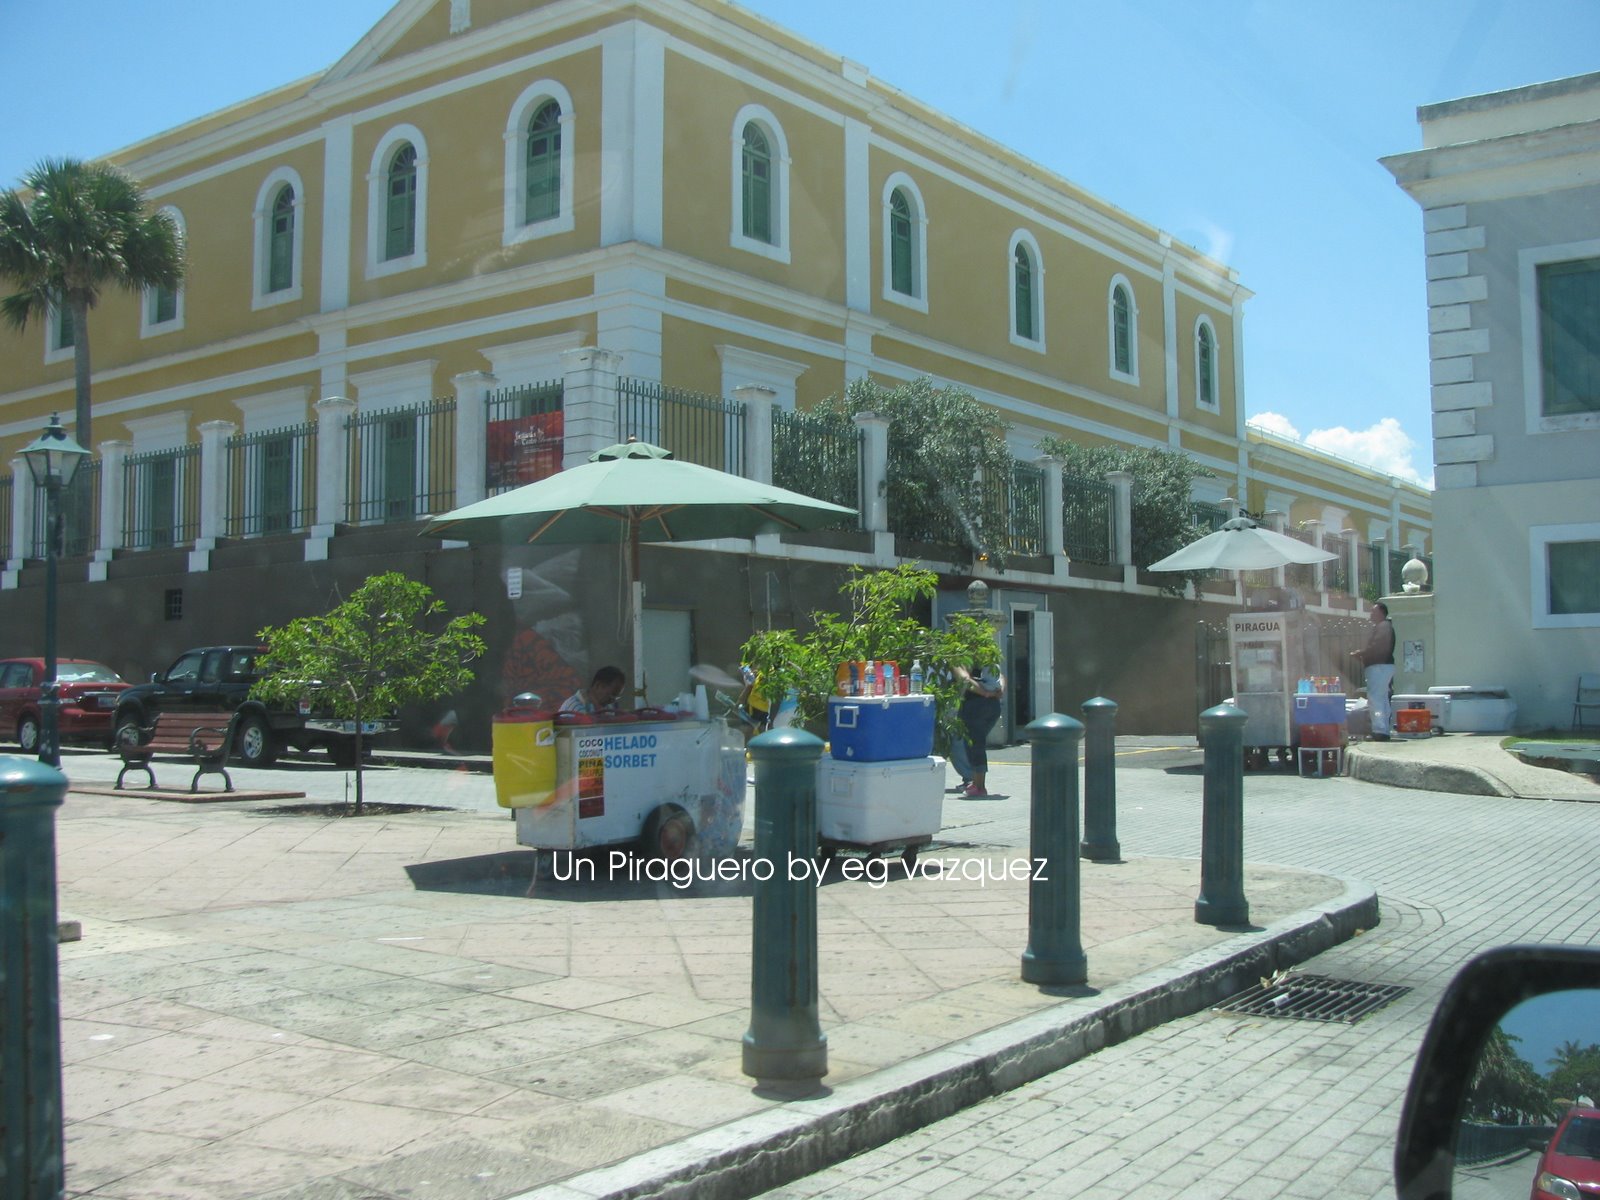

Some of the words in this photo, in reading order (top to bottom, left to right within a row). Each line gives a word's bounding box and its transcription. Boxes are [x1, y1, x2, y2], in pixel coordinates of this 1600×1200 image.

[1235, 622, 1280, 632] PIRAGUA
[579, 738, 604, 748] COCO
[604, 735, 657, 751] HELADO
[604, 754, 657, 769] SORBET
